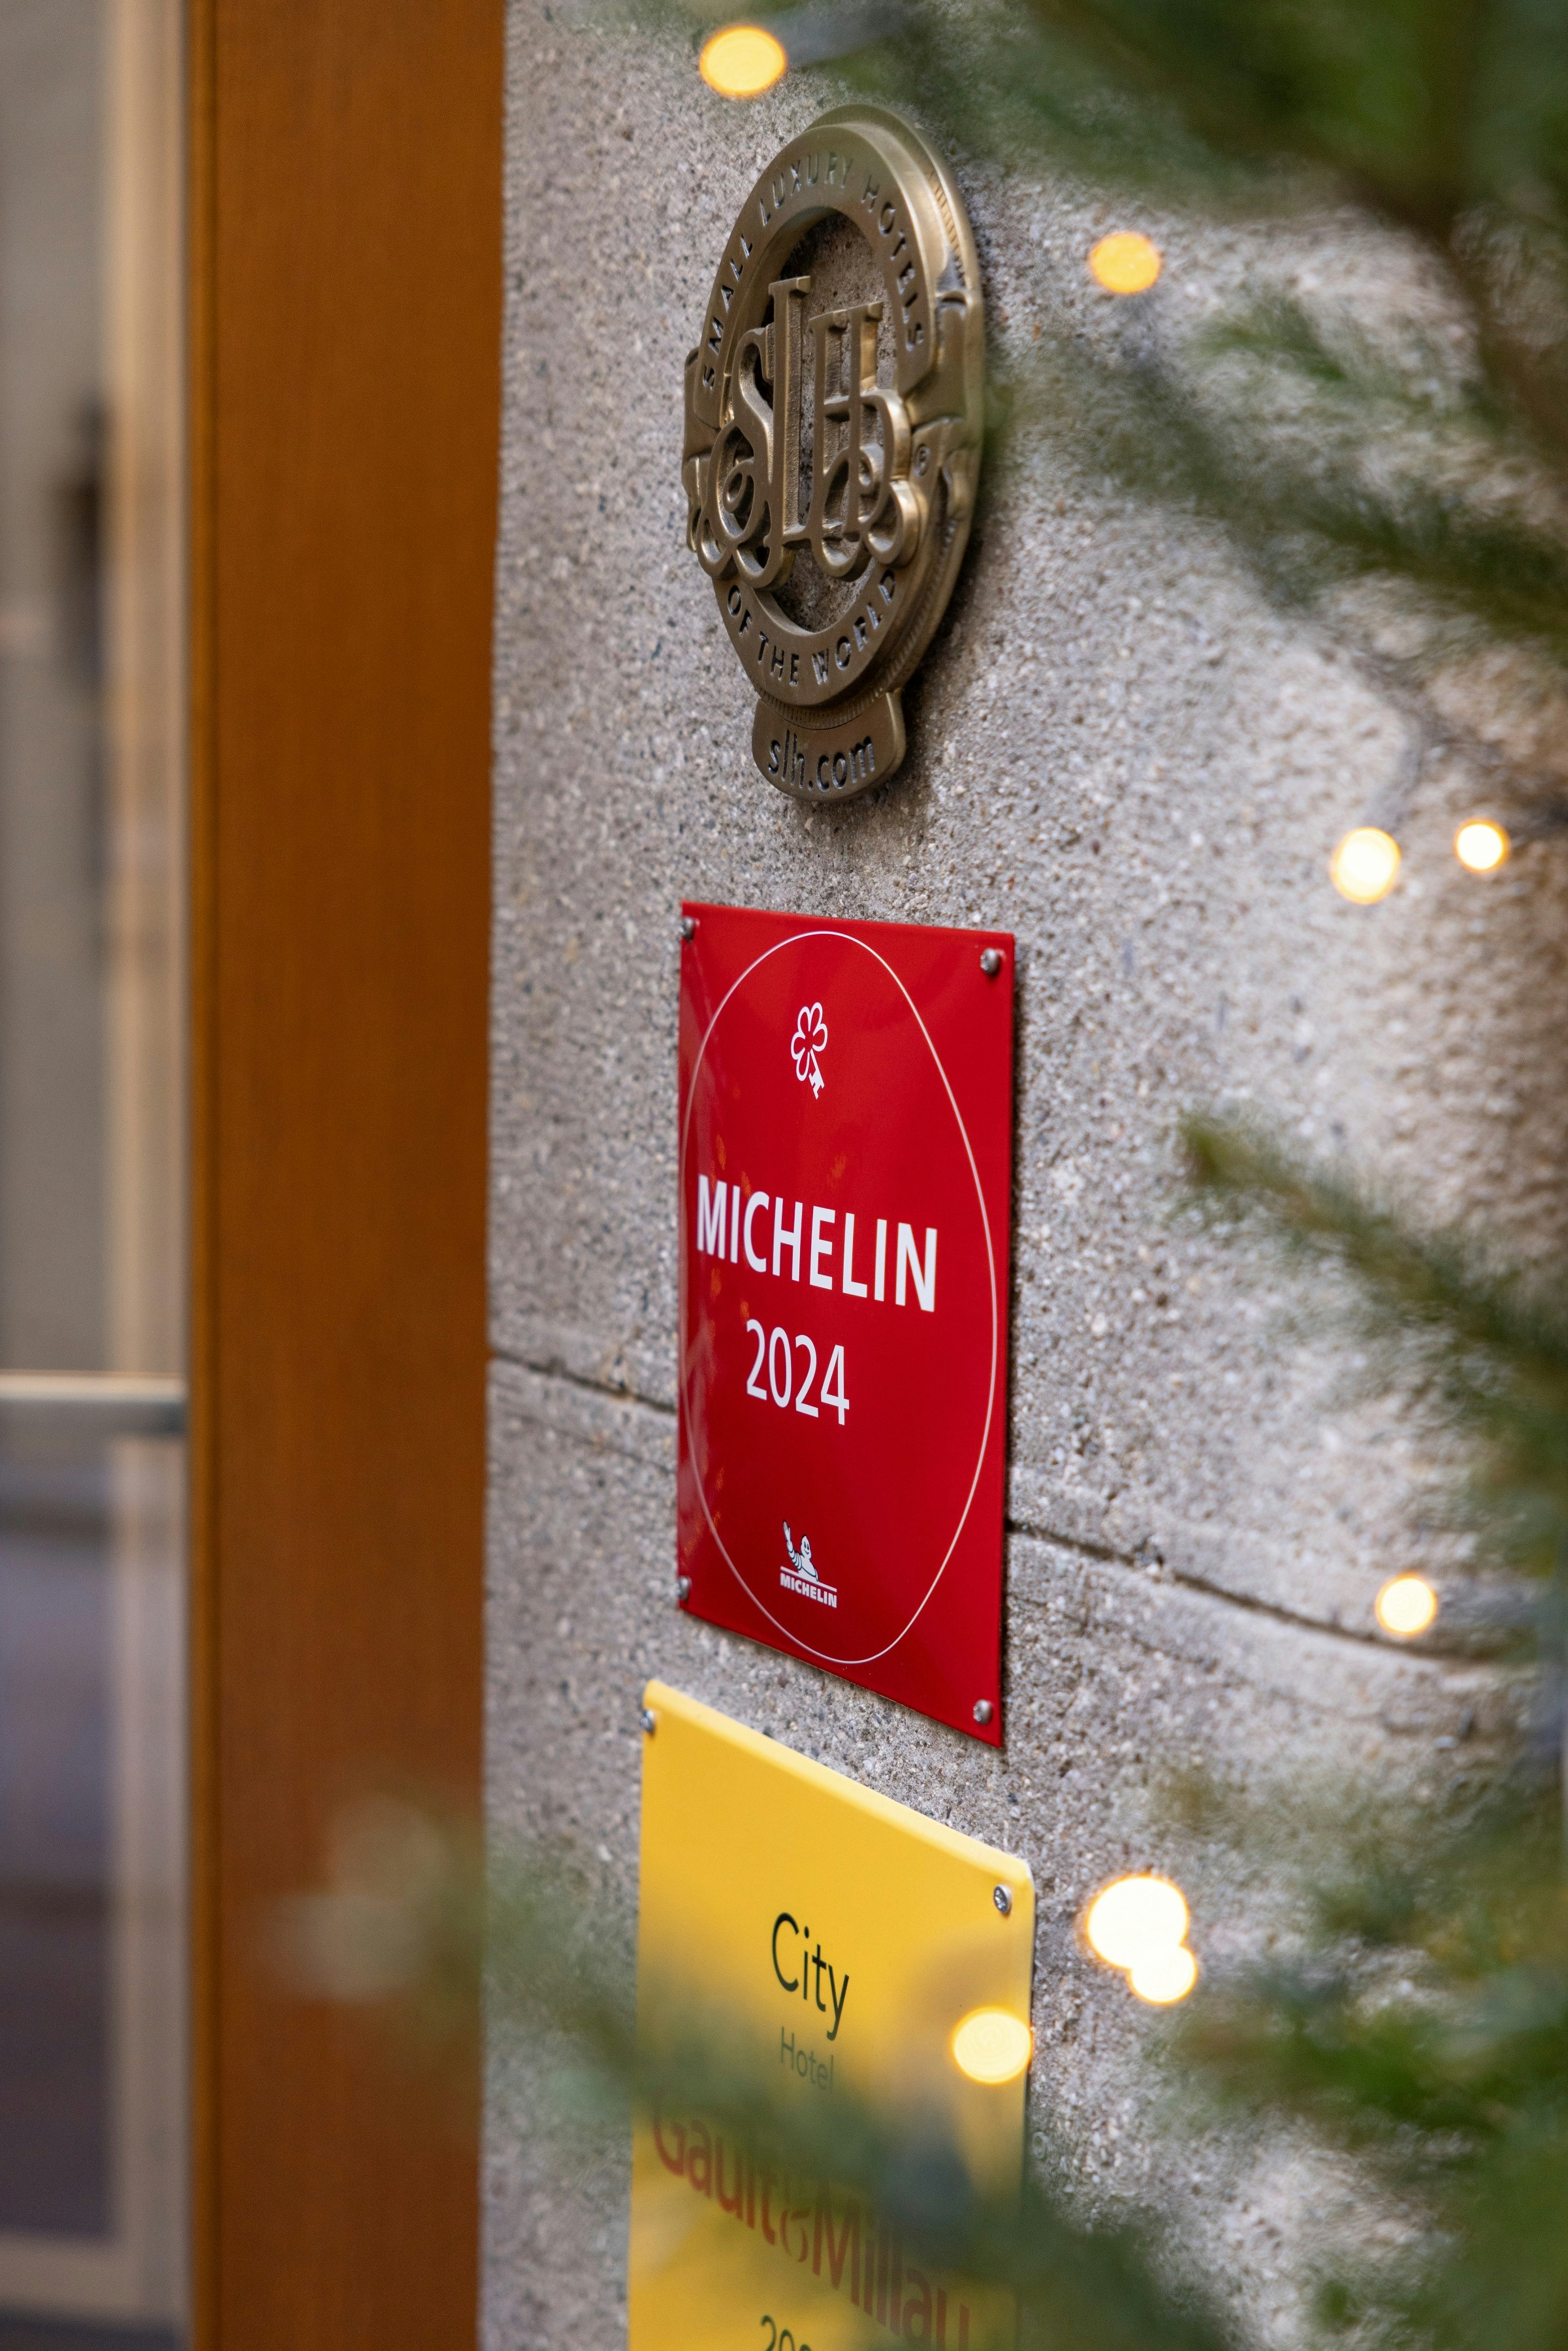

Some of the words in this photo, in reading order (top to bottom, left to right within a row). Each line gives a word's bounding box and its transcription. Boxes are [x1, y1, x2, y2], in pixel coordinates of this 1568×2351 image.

[701, 232, 754, 391] SMALL
[758, 152, 854, 227] LUXURY
[861, 174, 925, 353] HOTELS
[727, 584, 754, 637] OF
[758, 631, 800, 686] THE
[812, 569, 897, 685] WORLD
[768, 729, 876, 792] slh.com
[696, 1174, 938, 1313] MICHELIN
[746, 1319, 850, 1426] 2024
[780, 1573, 838, 1608] MICHELIN
[771, 1912, 850, 2041] City
[780, 2026, 834, 2094] Hotel
